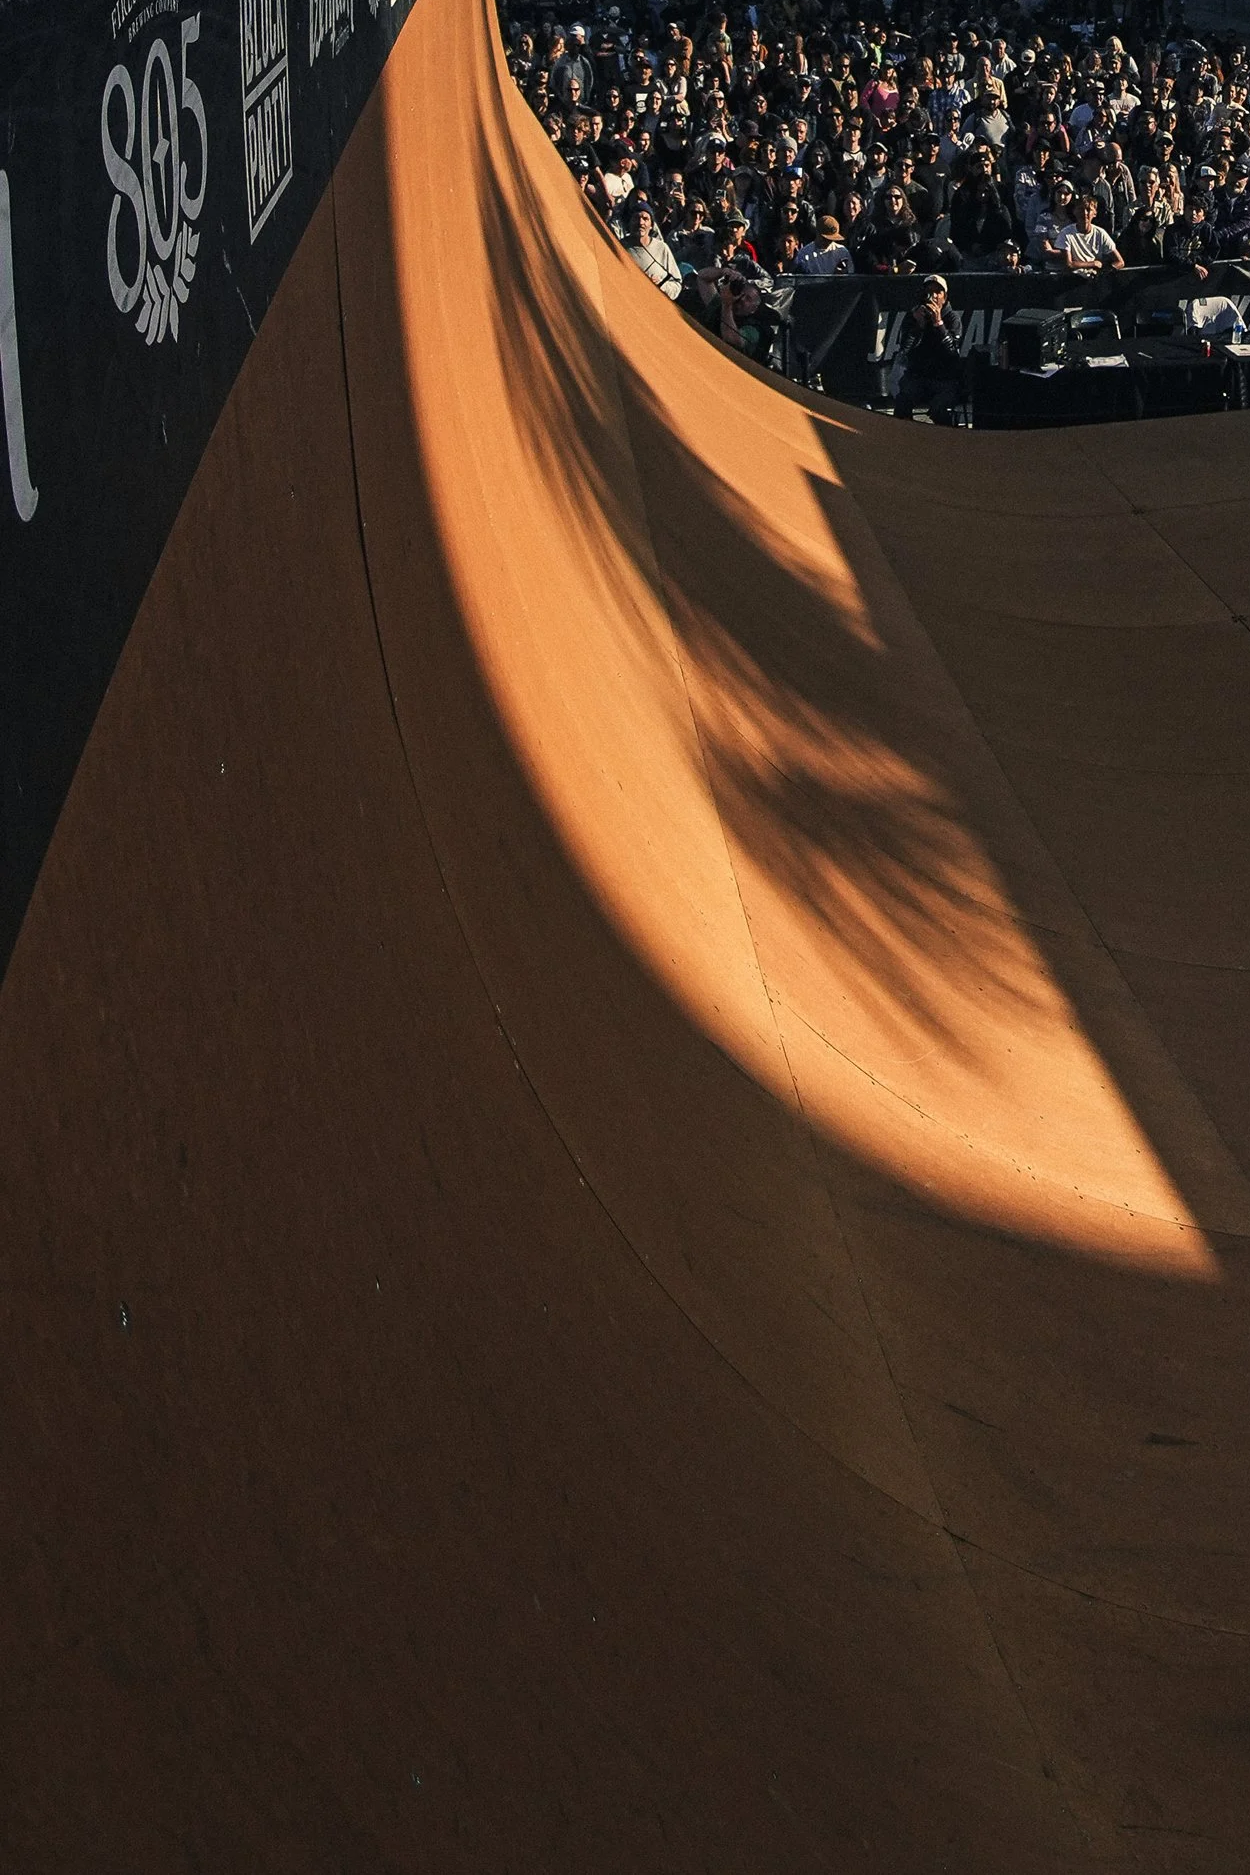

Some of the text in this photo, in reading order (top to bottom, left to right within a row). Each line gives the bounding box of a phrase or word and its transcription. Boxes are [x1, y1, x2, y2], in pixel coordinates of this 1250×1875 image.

[128, 3, 154, 44] BREWING
[101, 11, 208, 314] 805
[248, 76, 287, 216] PARTY
